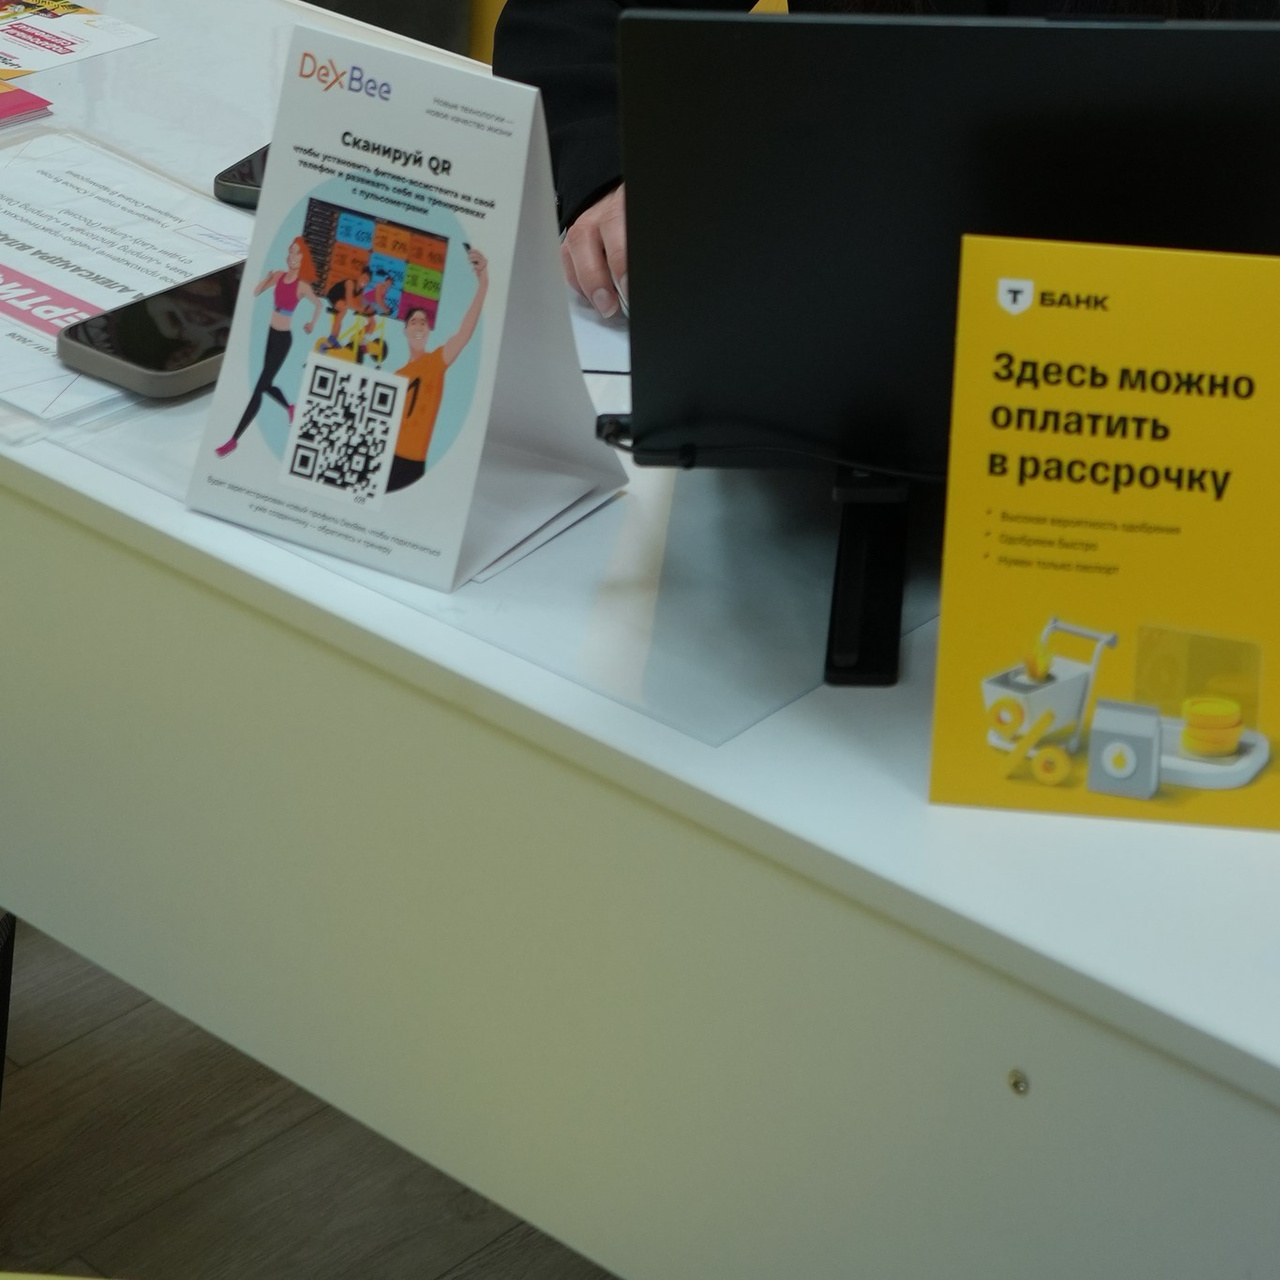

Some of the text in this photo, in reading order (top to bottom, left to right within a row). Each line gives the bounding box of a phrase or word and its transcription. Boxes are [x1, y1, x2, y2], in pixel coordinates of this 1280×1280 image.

[340, 131, 453, 177] Сканируй QR
[298, 158, 337, 177] телефон
[427, 195, 487, 220] тренировках
[320, 150, 373, 175] установить
[473, 196, 496, 210] свой
[358, 187, 430, 217] пульсометрами
[30, 248, 137, 294] АЛЕКСАНДРА
[1039, 291, 1110, 312] БАНК
[992, 351, 1256, 401] Здесь можно
[990, 404, 1171, 442] оплатить
[987, 451, 1232, 503] в рассрочку
